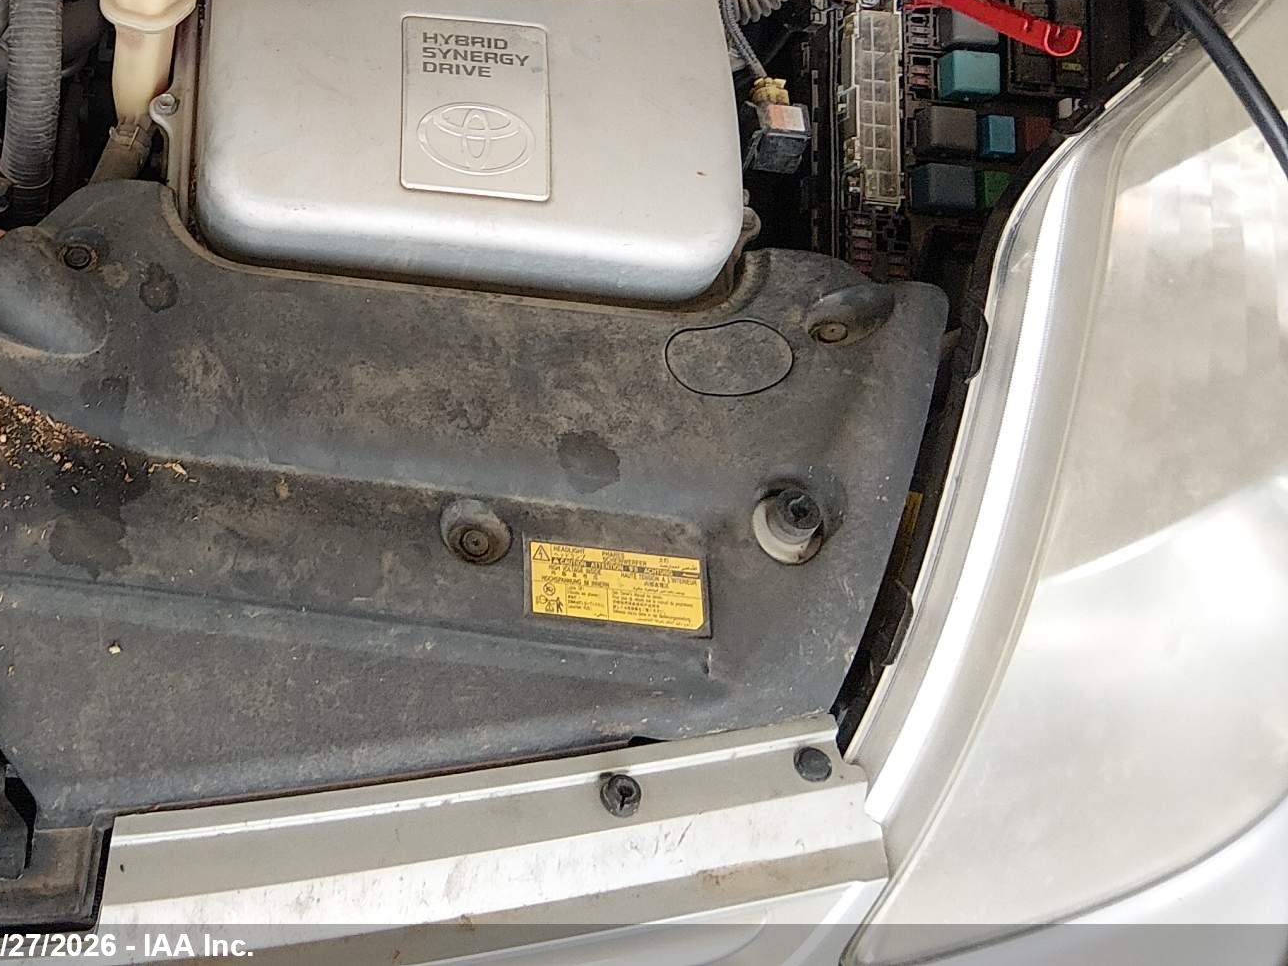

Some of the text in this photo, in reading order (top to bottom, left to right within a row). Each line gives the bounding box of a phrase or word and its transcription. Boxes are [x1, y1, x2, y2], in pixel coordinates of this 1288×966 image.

[422, 32, 508, 50] HYBRID
[422, 46, 530, 67] SYNERGY
[422, 61, 491, 78] DRIVE
[553, 545, 585, 555] HEADLIGHT
